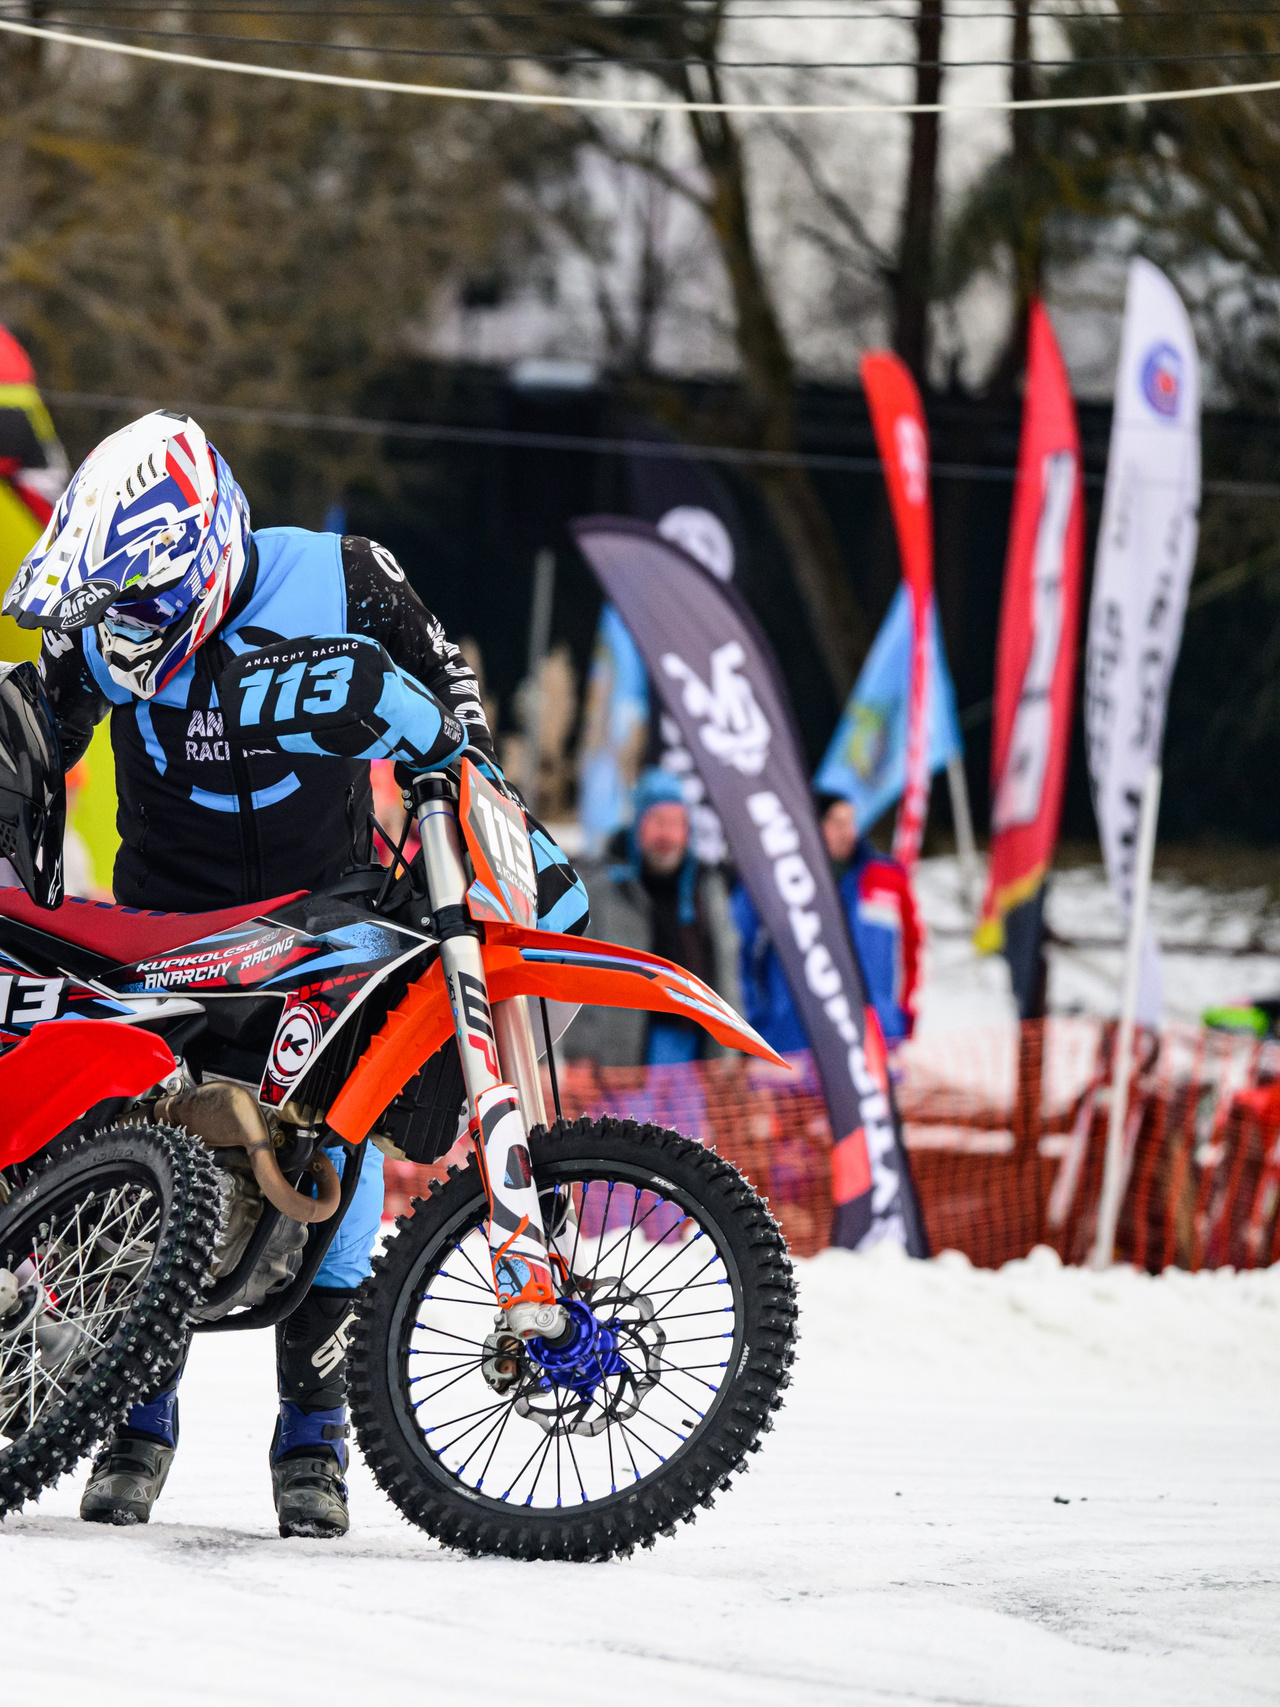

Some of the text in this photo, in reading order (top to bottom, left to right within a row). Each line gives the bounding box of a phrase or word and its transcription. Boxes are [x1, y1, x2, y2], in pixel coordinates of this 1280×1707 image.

[183, 466, 234, 599] 100%
[245, 641, 359, 668] ANARCHY RACING
[239, 655, 354, 727] 113
[477, 793, 537, 892] 113
[145, 934, 296, 989] ANARCHY RACING
[447, 974, 456, 1002] XACT
[458, 971, 500, 1081] WP
